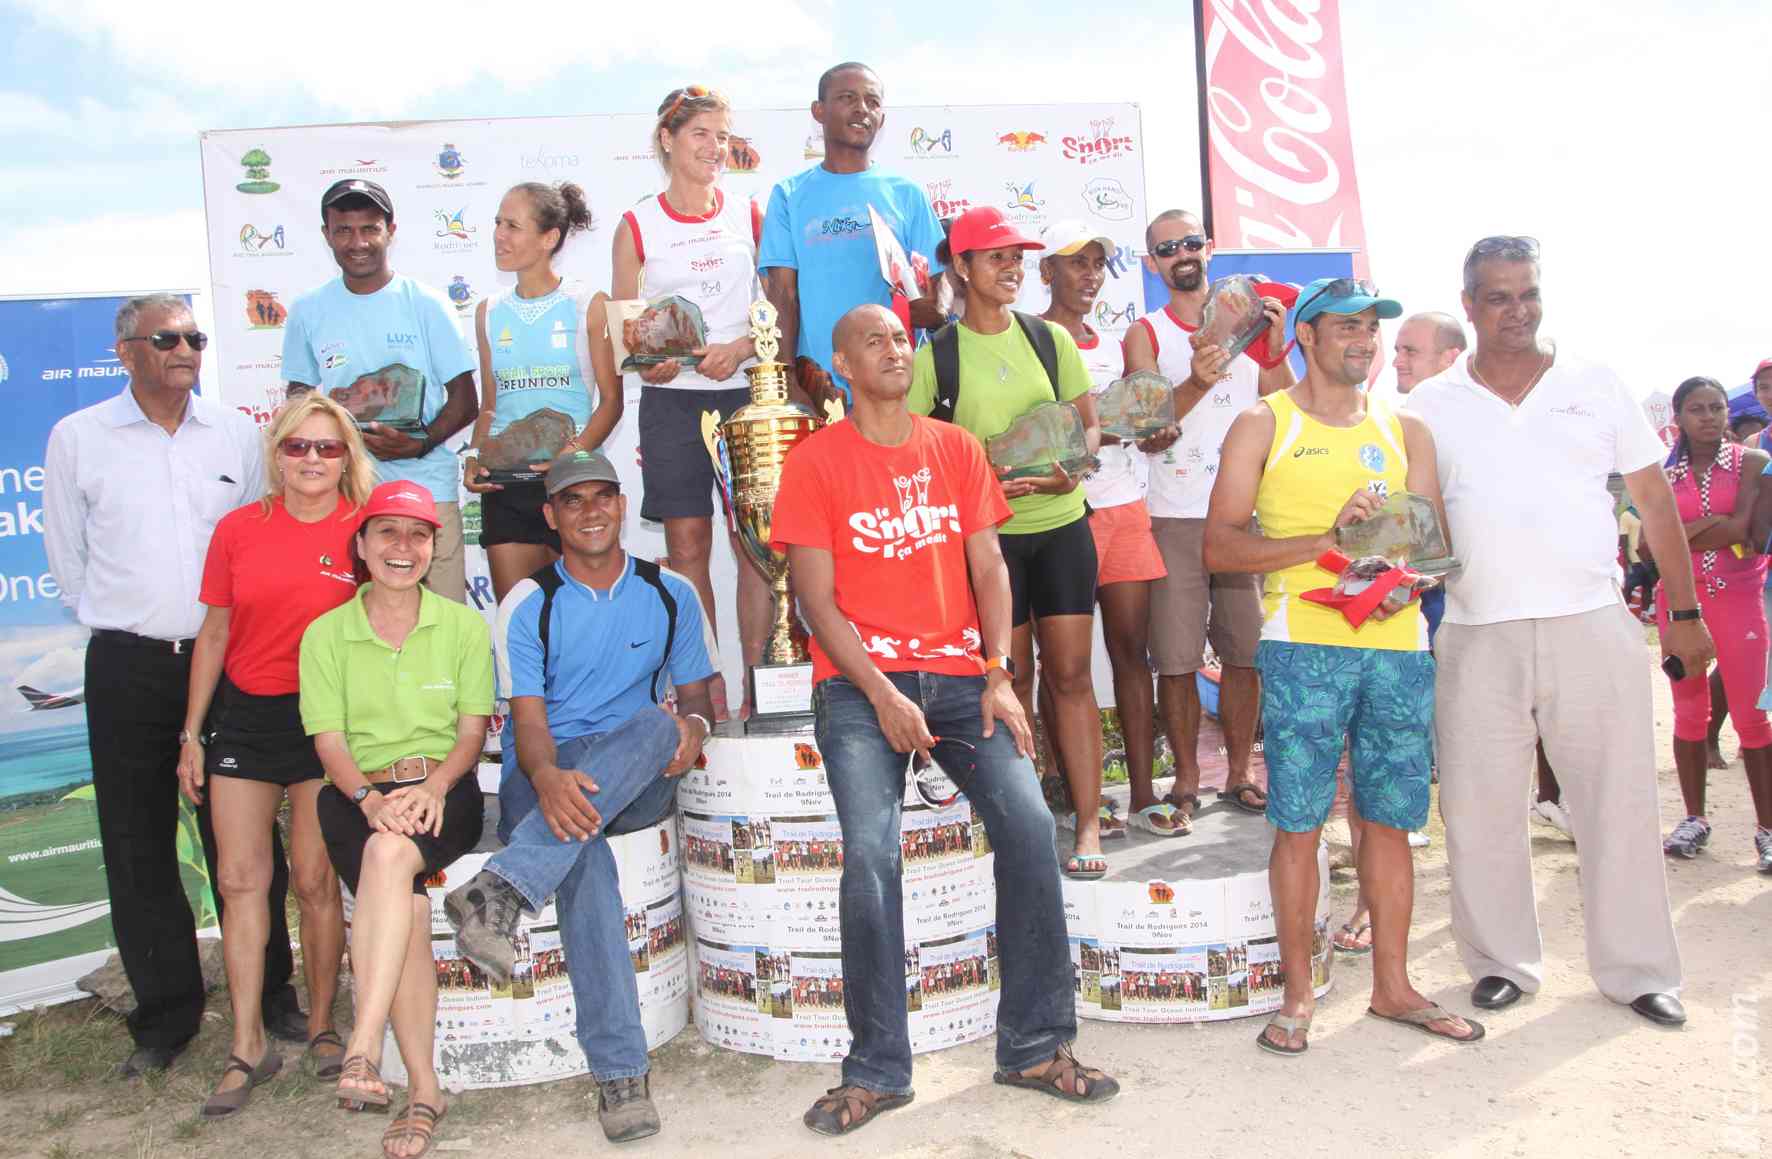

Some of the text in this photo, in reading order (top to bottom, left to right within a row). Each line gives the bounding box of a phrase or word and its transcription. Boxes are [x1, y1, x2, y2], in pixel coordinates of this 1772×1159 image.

[500, 376, 570, 391] REUNION
[875, 507, 890, 520] le
[848, 503, 962, 559] Sport
[897, 547, 912, 560] ça
[1189, 920, 1208, 929] 2014
